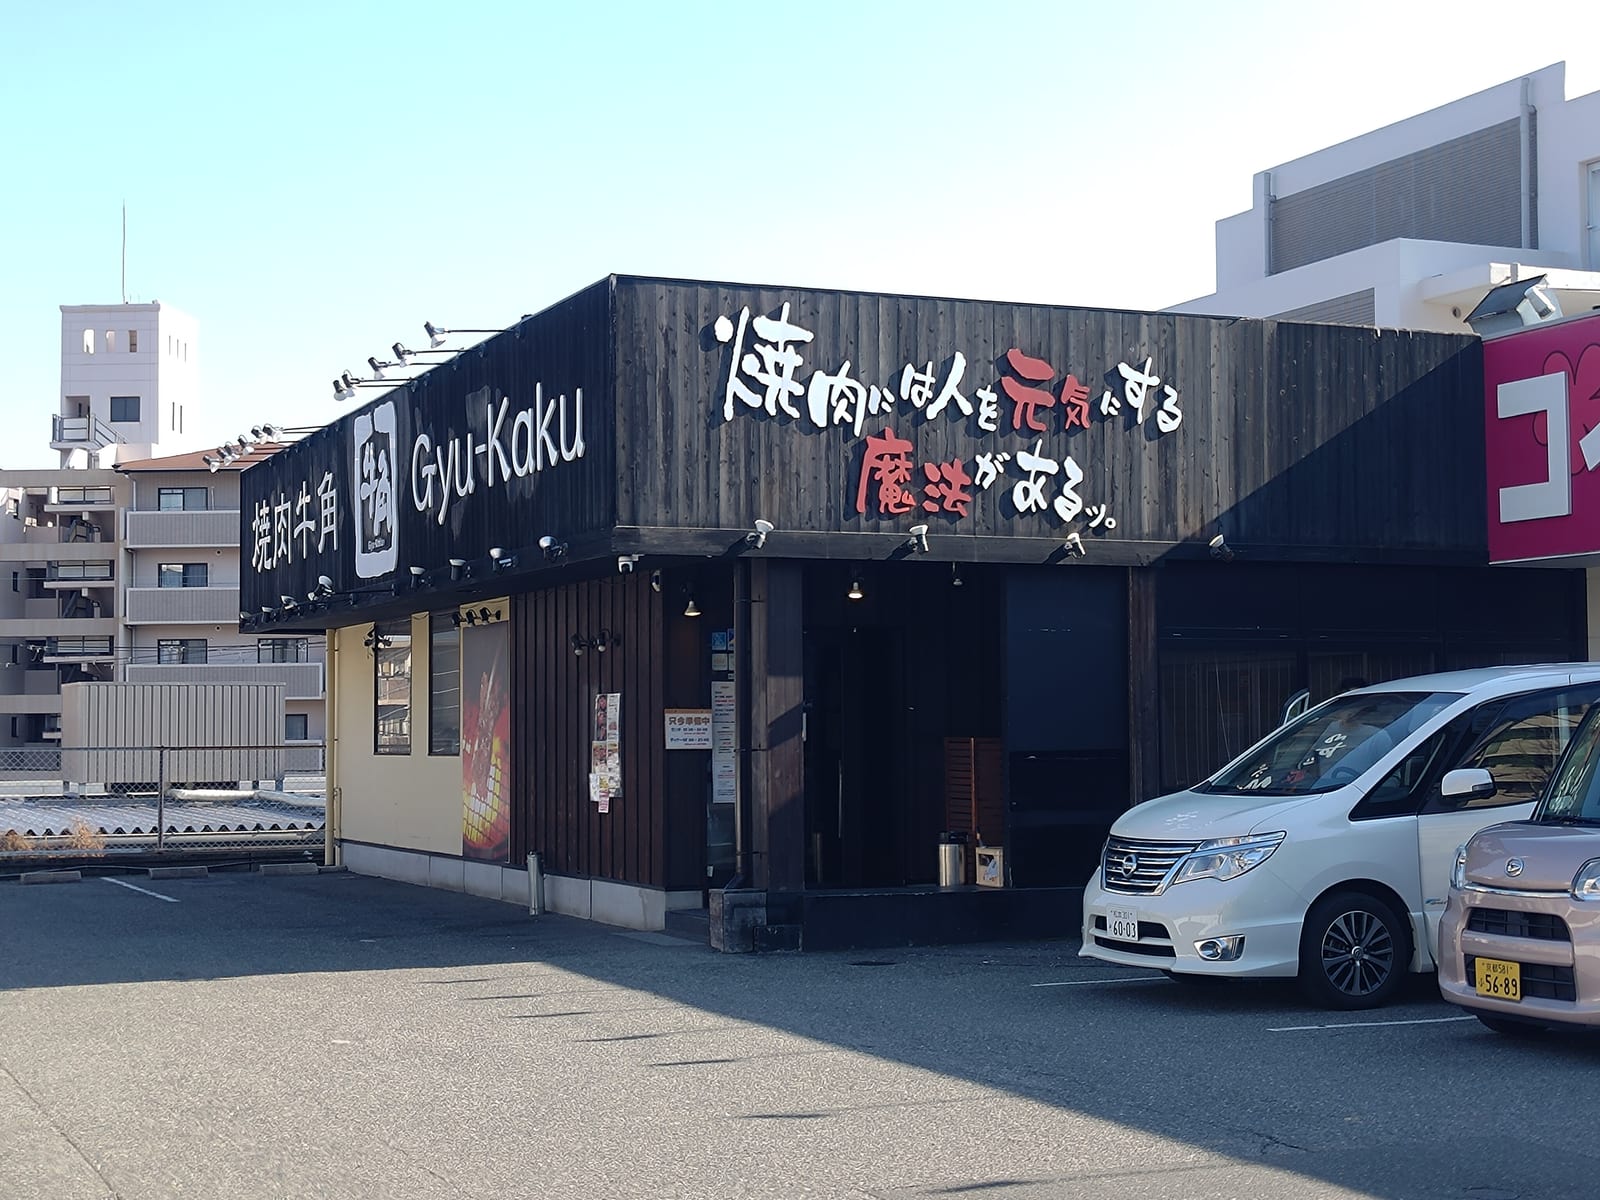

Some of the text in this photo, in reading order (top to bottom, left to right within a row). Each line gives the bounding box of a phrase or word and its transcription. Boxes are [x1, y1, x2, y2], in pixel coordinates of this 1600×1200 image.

[714, 301, 1183, 437] 焼肉には人を元気にする
[411, 382, 586, 525] Gyu-Kaku
[1497, 371, 1600, 523] コ
[251, 471, 339, 573] 焼肉牛角
